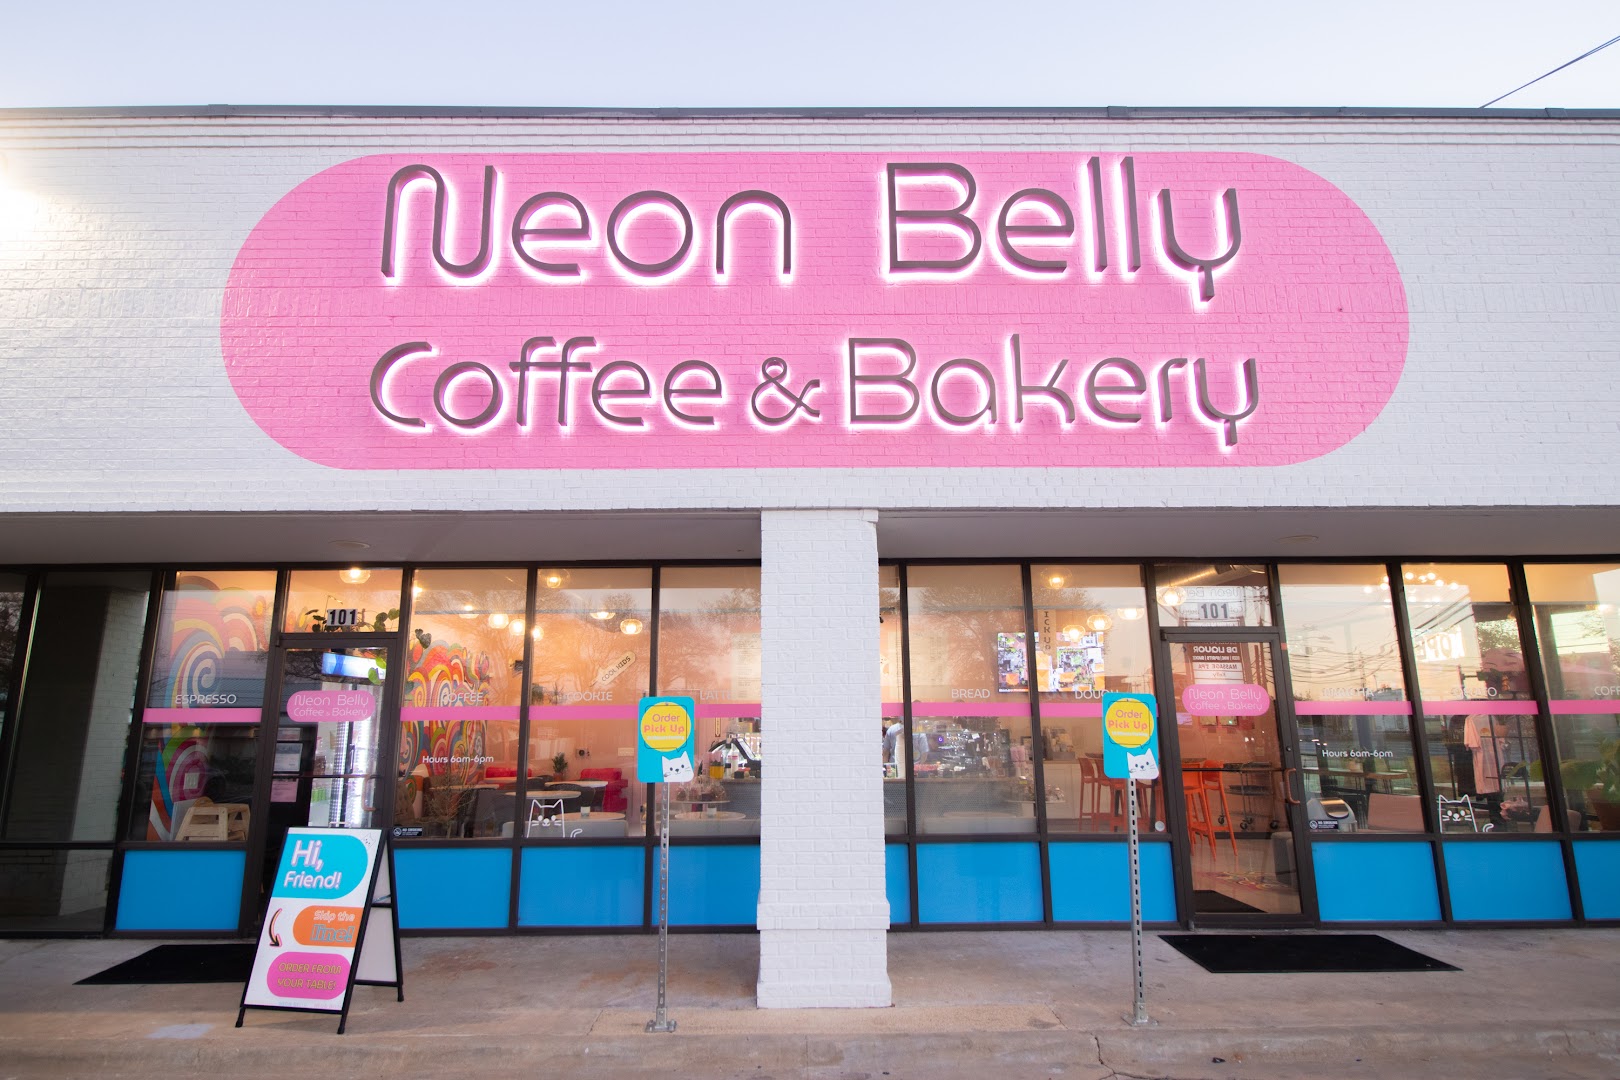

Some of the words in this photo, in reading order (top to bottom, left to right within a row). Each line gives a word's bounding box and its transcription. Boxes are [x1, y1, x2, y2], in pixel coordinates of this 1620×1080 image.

[381, 164, 791, 279] Neon
[886, 156, 1242, 302] Belly
[370, 336, 722, 429] Coffee
[751, 356, 821, 426] &
[848, 334, 1258, 447] Bakery
[329, 609, 357, 625] 101
[1201, 603, 1228, 619] 101
[602, 667, 618, 682] COOL
[616, 656, 631, 670] KIDS
[174, 693, 237, 705] ESPRESSO
[441, 692, 484, 702] COFFEE
[566, 691, 613, 702] COOKIE
[951, 688, 991, 699] BREAD
[1188, 688, 1225, 700] Neon
[1230, 688, 1262, 702] Belly
[294, 694, 331, 706] Neon
[337, 694, 369, 708] Belly
[1189, 701, 1220, 711] Coffee
[1227, 701, 1263, 713] Bakery
[293, 707, 325, 717] Coffee
[332, 707, 369, 719] Bakery
[652, 713, 681, 723] Order
[1115, 709, 1143, 719] Order
[643, 724, 666, 733] Pick
[669, 724, 685, 735] Up
[1108, 719, 1130, 729] Pick
[1133, 720, 1148, 731] Up
[422, 755, 448, 764] Hours
[450, 755, 495, 765] 6am-6pm
[1322, 749, 1348, 758] Hours
[1350, 749, 1394, 760] 6am-6pm
[291, 840, 324, 872] Hi,
[283, 870, 342, 889] Friend!
[313, 909, 336, 924] Skip
[337, 911, 355, 922] the
[310, 923, 356, 943] line!
[279, 963, 310, 974] ORDER
[311, 964, 342, 974] FROM
[277, 977, 304, 989] YOUR
[306, 979, 337, 990] TABLE!
